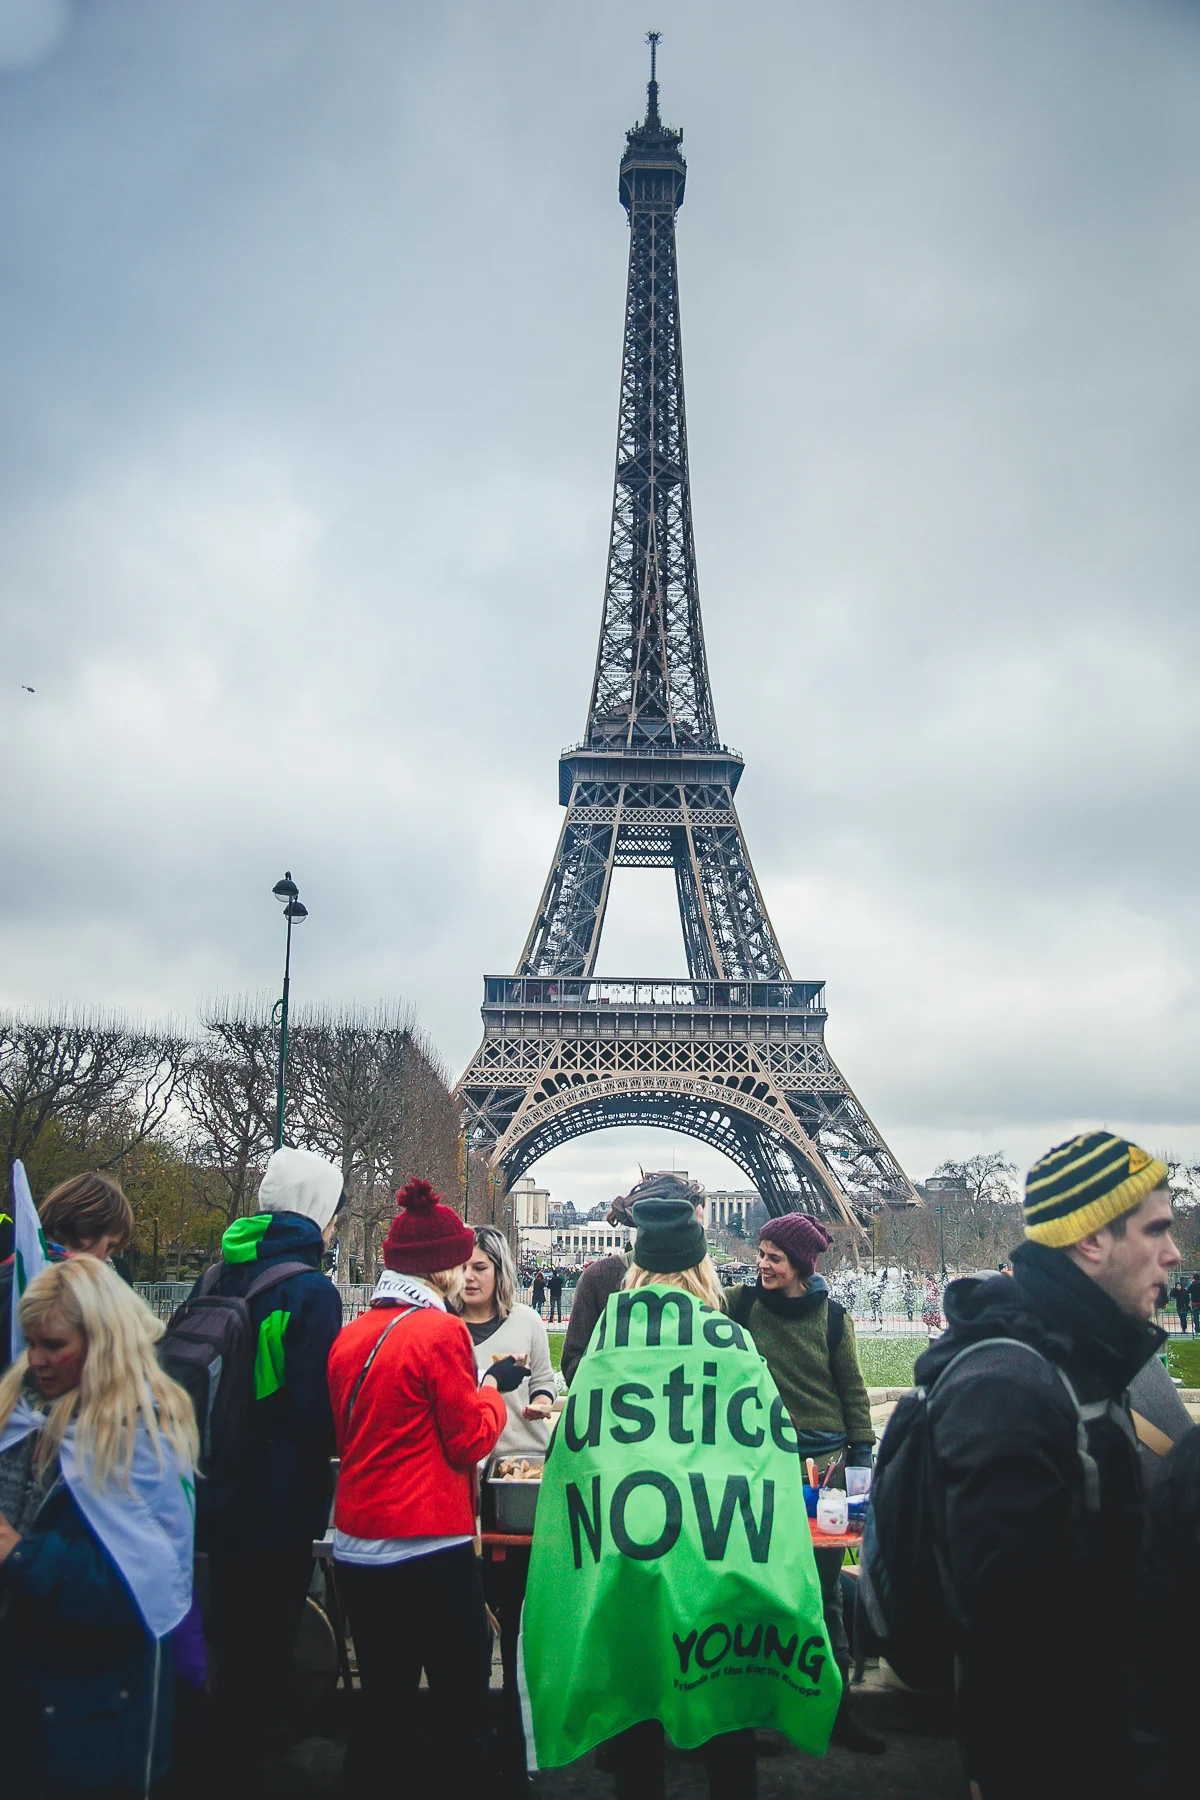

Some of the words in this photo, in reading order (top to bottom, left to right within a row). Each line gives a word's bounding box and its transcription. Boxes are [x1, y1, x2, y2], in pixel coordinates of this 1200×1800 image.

[544, 1362, 799, 1464] ustice
[566, 1470, 775, 1570] NOW
[672, 1622, 826, 1684] YOUNG
